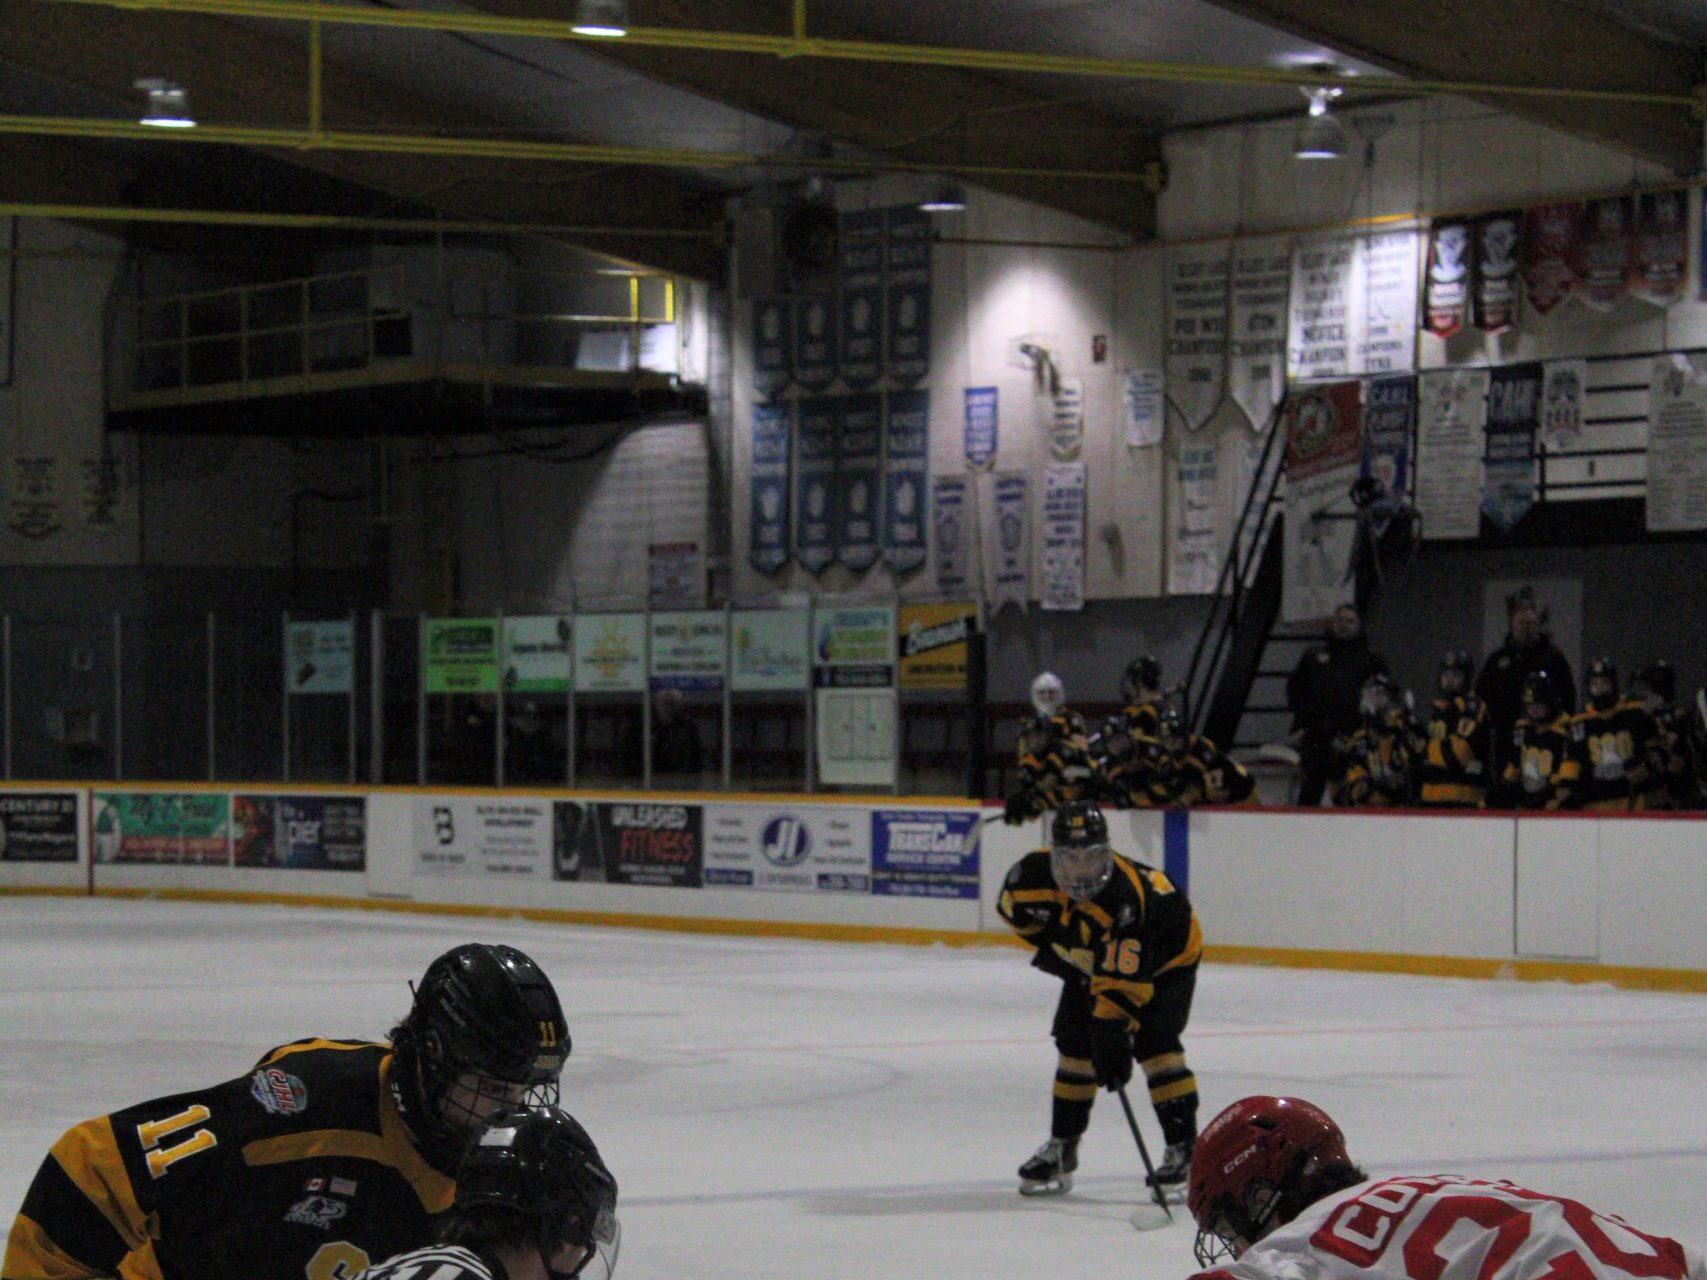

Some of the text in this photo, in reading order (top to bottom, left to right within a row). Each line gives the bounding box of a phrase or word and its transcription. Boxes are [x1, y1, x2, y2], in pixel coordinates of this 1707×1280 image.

[619, 829, 695, 865] FITNESS
[1101, 937, 1142, 976] 16
[538, 1021, 557, 1047] 11
[137, 1103, 218, 1181] 11
[1223, 1144, 1257, 1175] CCM
